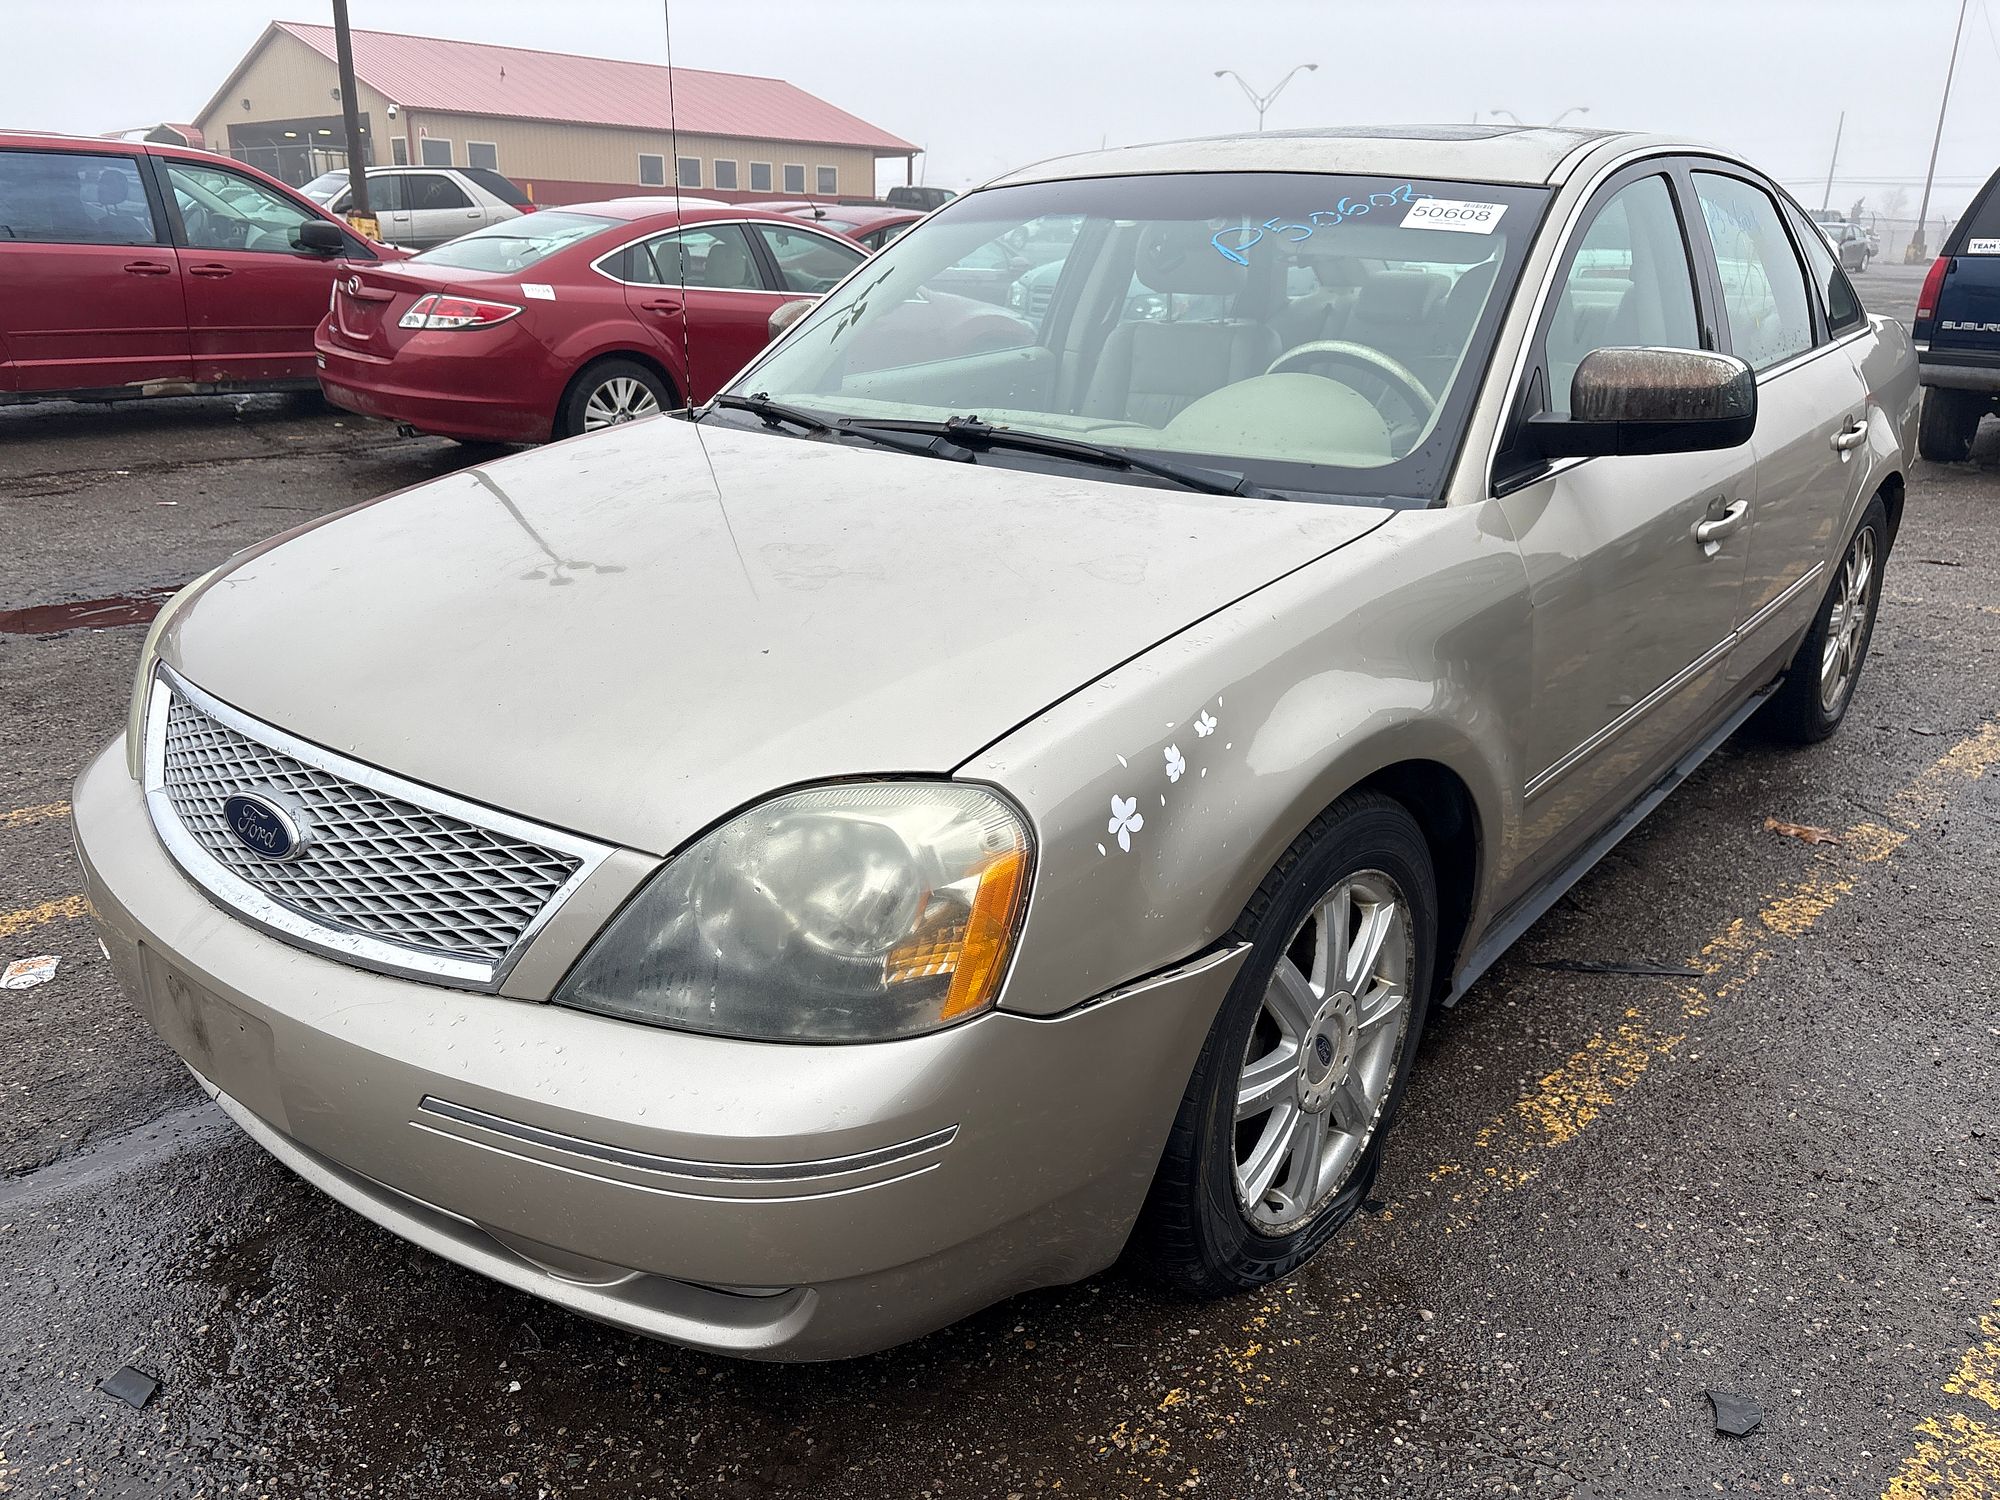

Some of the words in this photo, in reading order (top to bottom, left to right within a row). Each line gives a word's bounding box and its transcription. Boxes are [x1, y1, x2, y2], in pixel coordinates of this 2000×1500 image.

[1413, 206, 1491, 221] 50608
[1941, 320, 2000, 332] SUBUR
[237, 804, 278, 849] Ford
